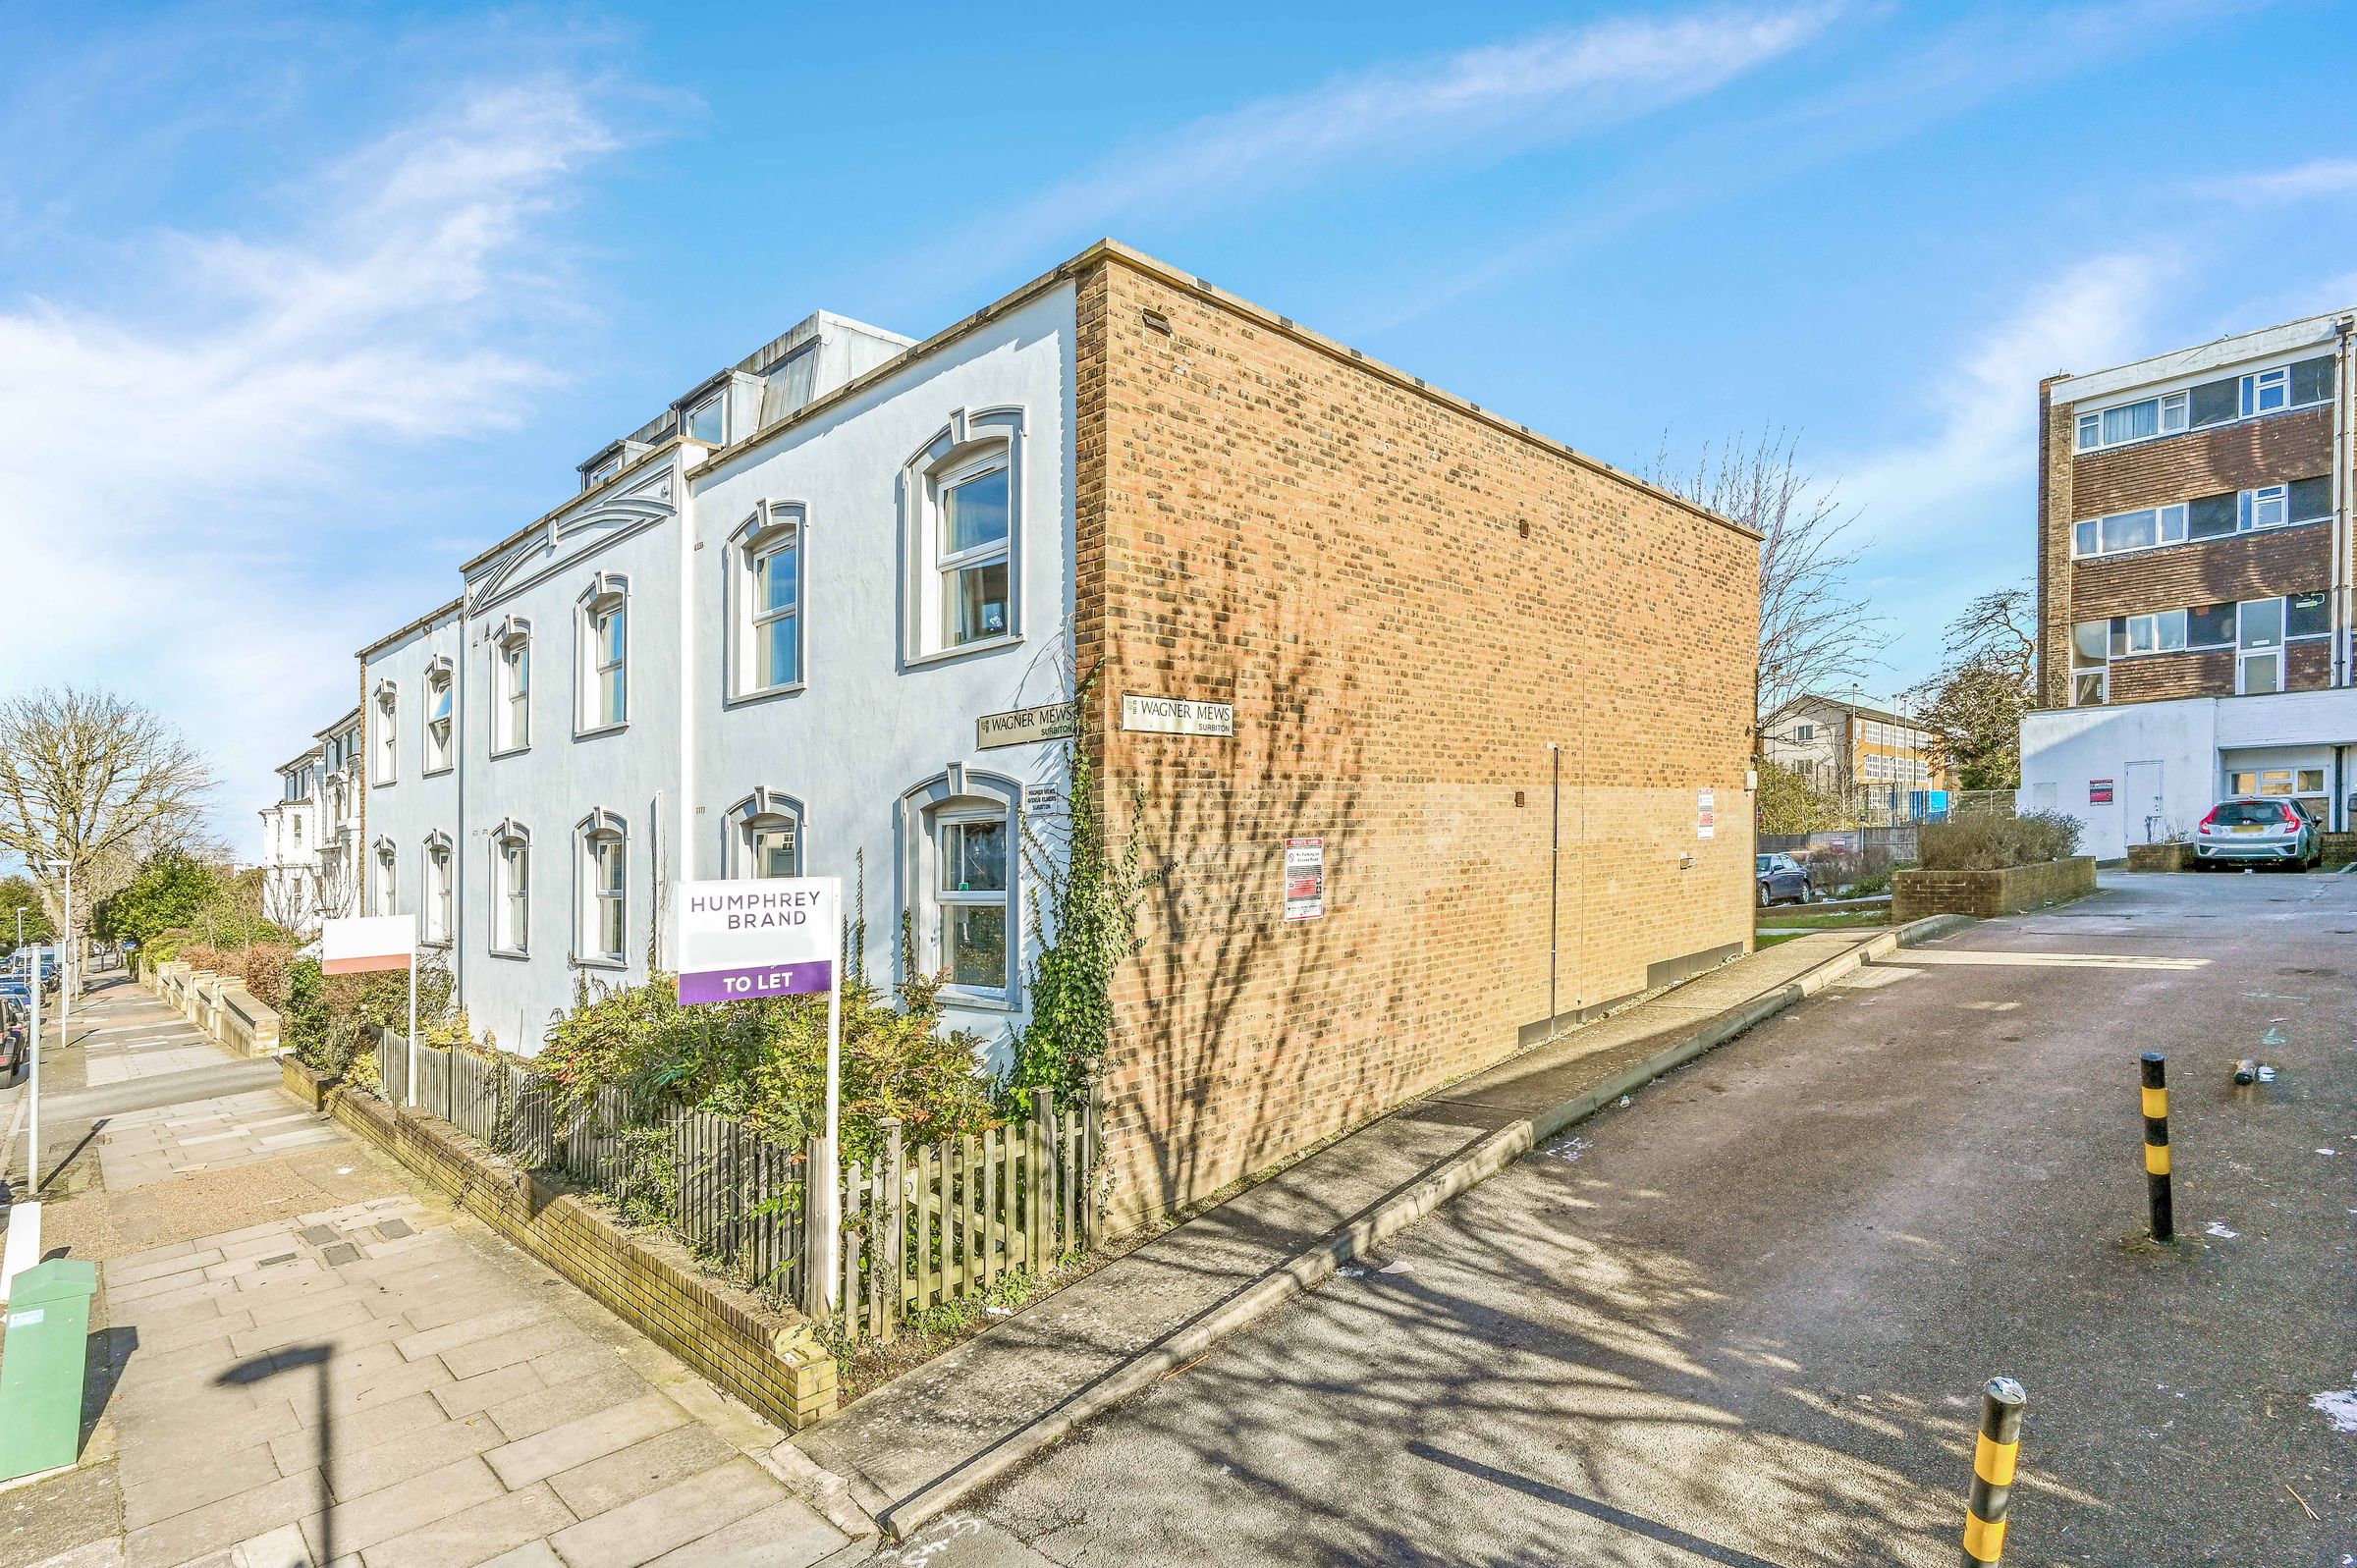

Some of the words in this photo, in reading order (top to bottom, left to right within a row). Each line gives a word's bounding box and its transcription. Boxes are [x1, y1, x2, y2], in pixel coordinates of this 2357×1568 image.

[992, 713, 1034, 732] WAGNER
[1039, 706, 1072, 725] MEWS
[1141, 700, 1191, 719] WAGNER
[1197, 705, 1231, 722] MEWS
[1041, 724, 1072, 736] SURBITON
[1198, 723, 1231, 732] SURBITON
[690, 891, 821, 913] HUMPHREY
[728, 910, 806, 930] BRAND
[723, 977, 751, 994] TO
[757, 972, 793, 991] LET
